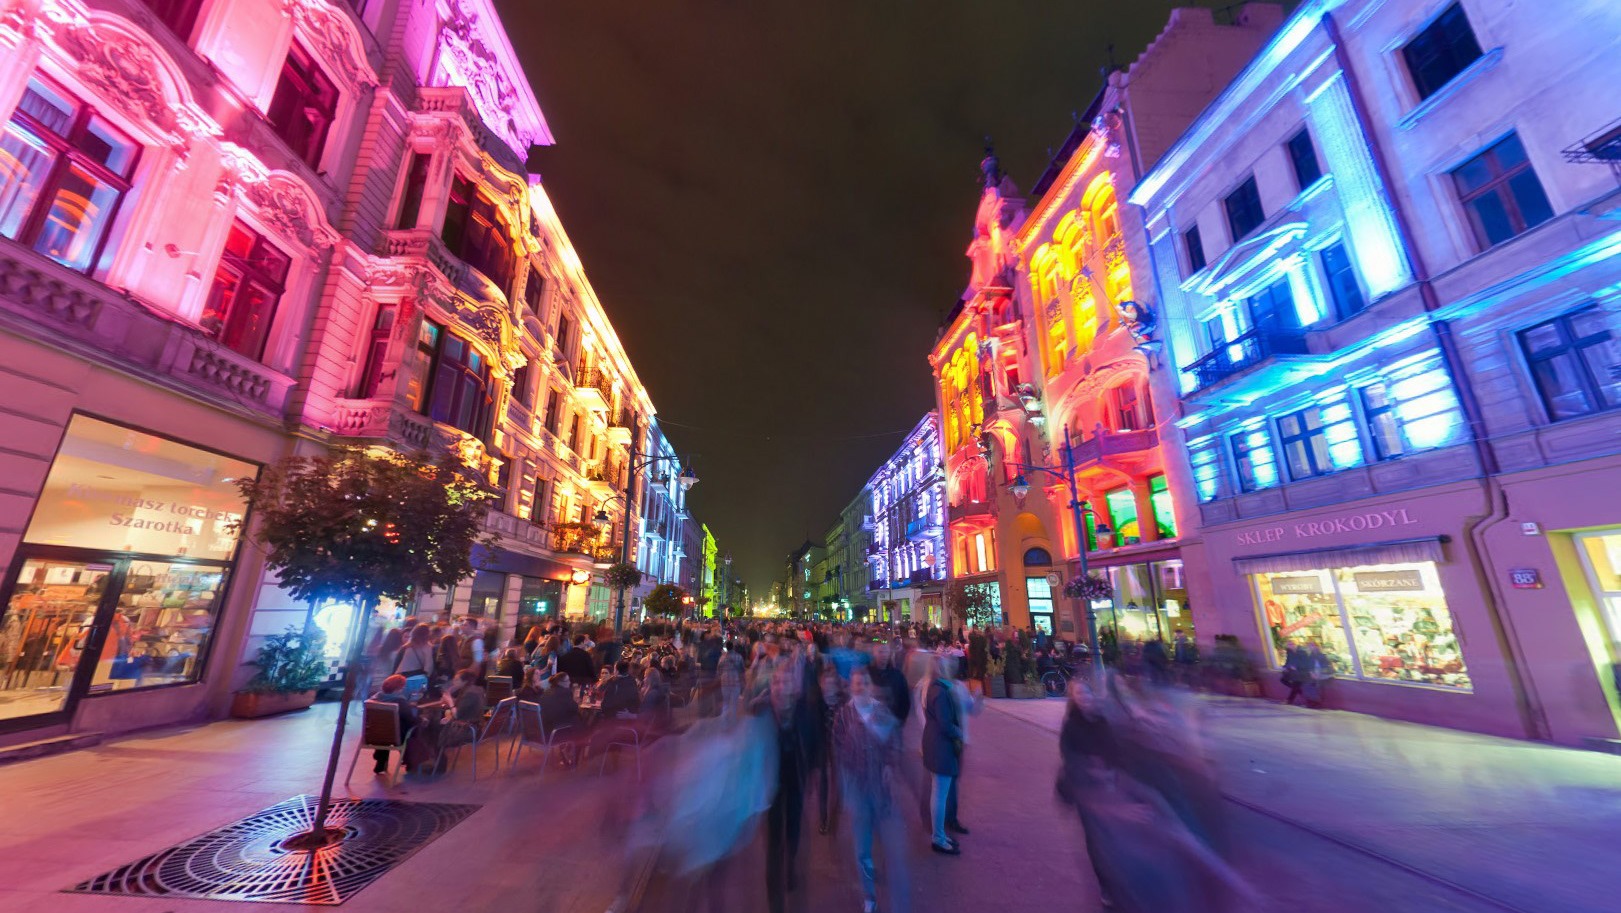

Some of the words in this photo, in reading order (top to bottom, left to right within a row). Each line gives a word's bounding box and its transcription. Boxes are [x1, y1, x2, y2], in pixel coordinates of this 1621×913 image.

[171, 499, 232, 523] torebek
[109, 512, 193, 535] Szarotka
[1237, 528, 1284, 545] SKLEP
[1295, 509, 1417, 537] KROKODYL
